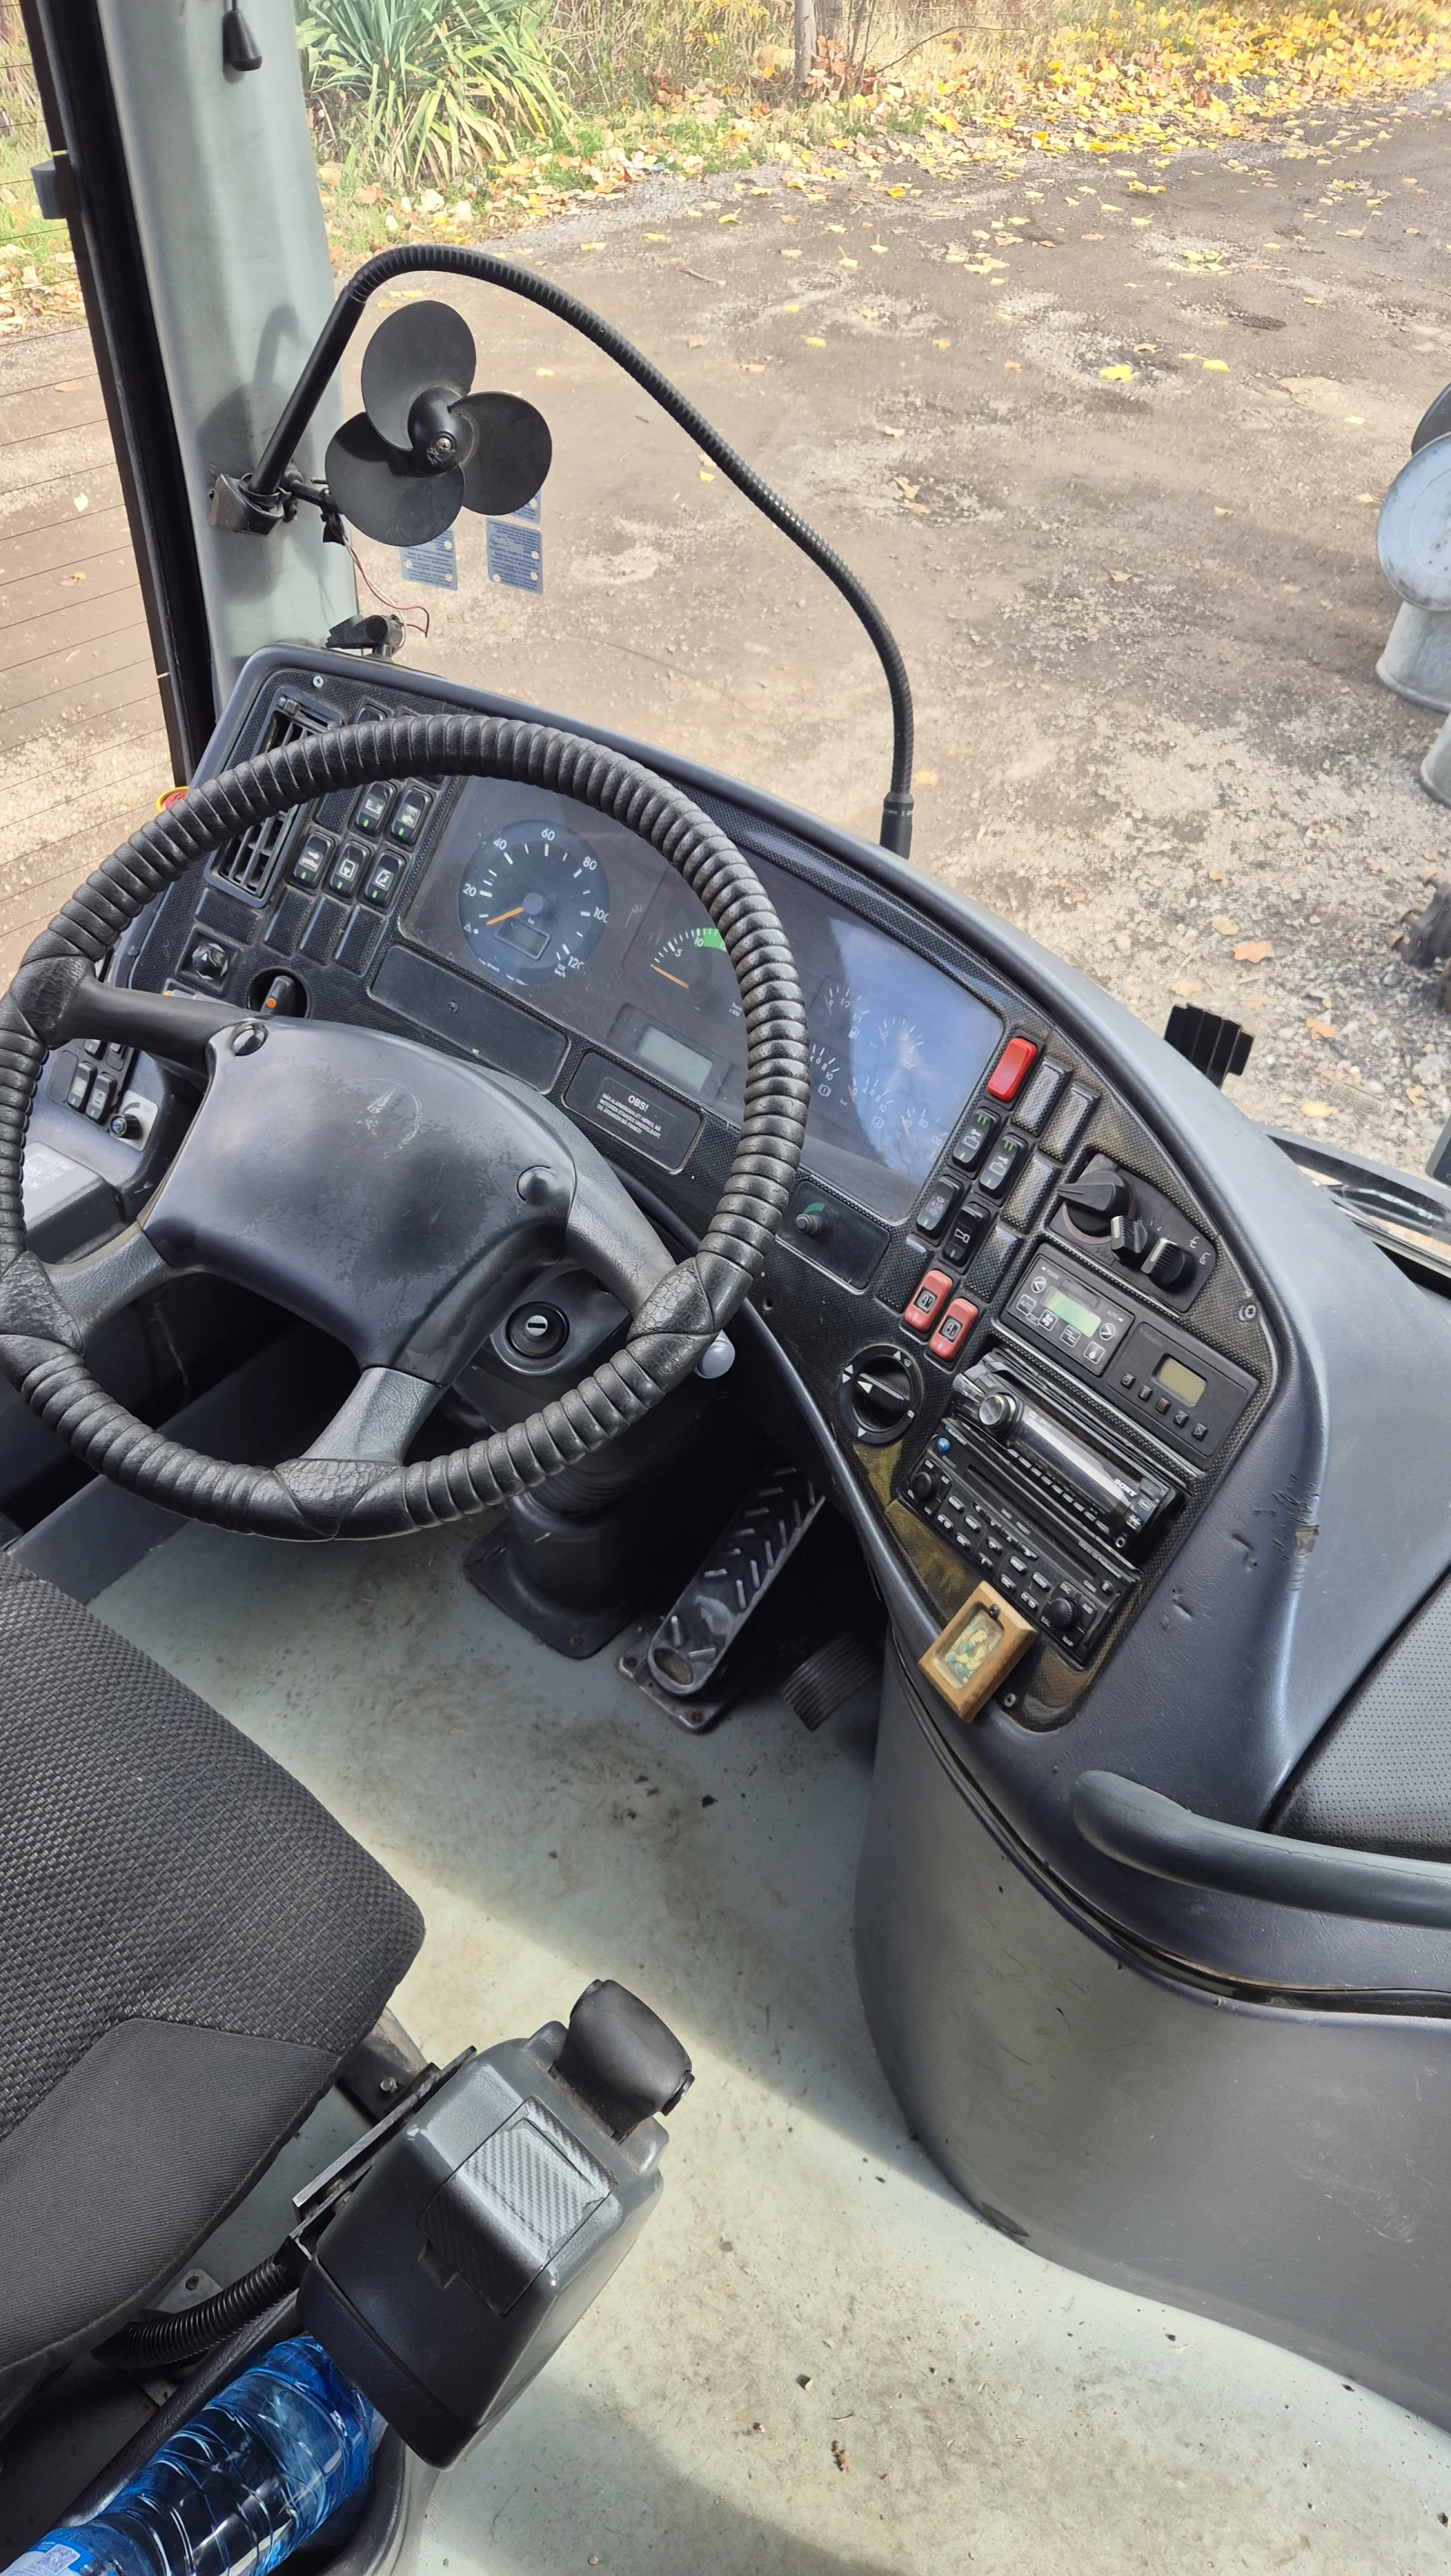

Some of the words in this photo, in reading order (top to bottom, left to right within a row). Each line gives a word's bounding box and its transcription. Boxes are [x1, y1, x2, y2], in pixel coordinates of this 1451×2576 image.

[540, 828, 555, 841] 60
[493, 837, 508, 851] 40
[582, 856, 598, 870] 80
[463, 883, 477, 897] 20
[694, 937, 704, 948] 10
[675, 948, 683, 957] 5
[815, 1056, 822, 1064] 6
[821, 1063, 827, 1071] 8
[824, 1071, 833, 1081] 10
[628, 1094, 649, 1113] OBS!
[878, 1103, 887, 1113] 10
[930, 1134, 942, 1146] 120
[1018, 1298, 1033, 1312] AUTO
[1114, 1478, 1138, 1497] SONY
